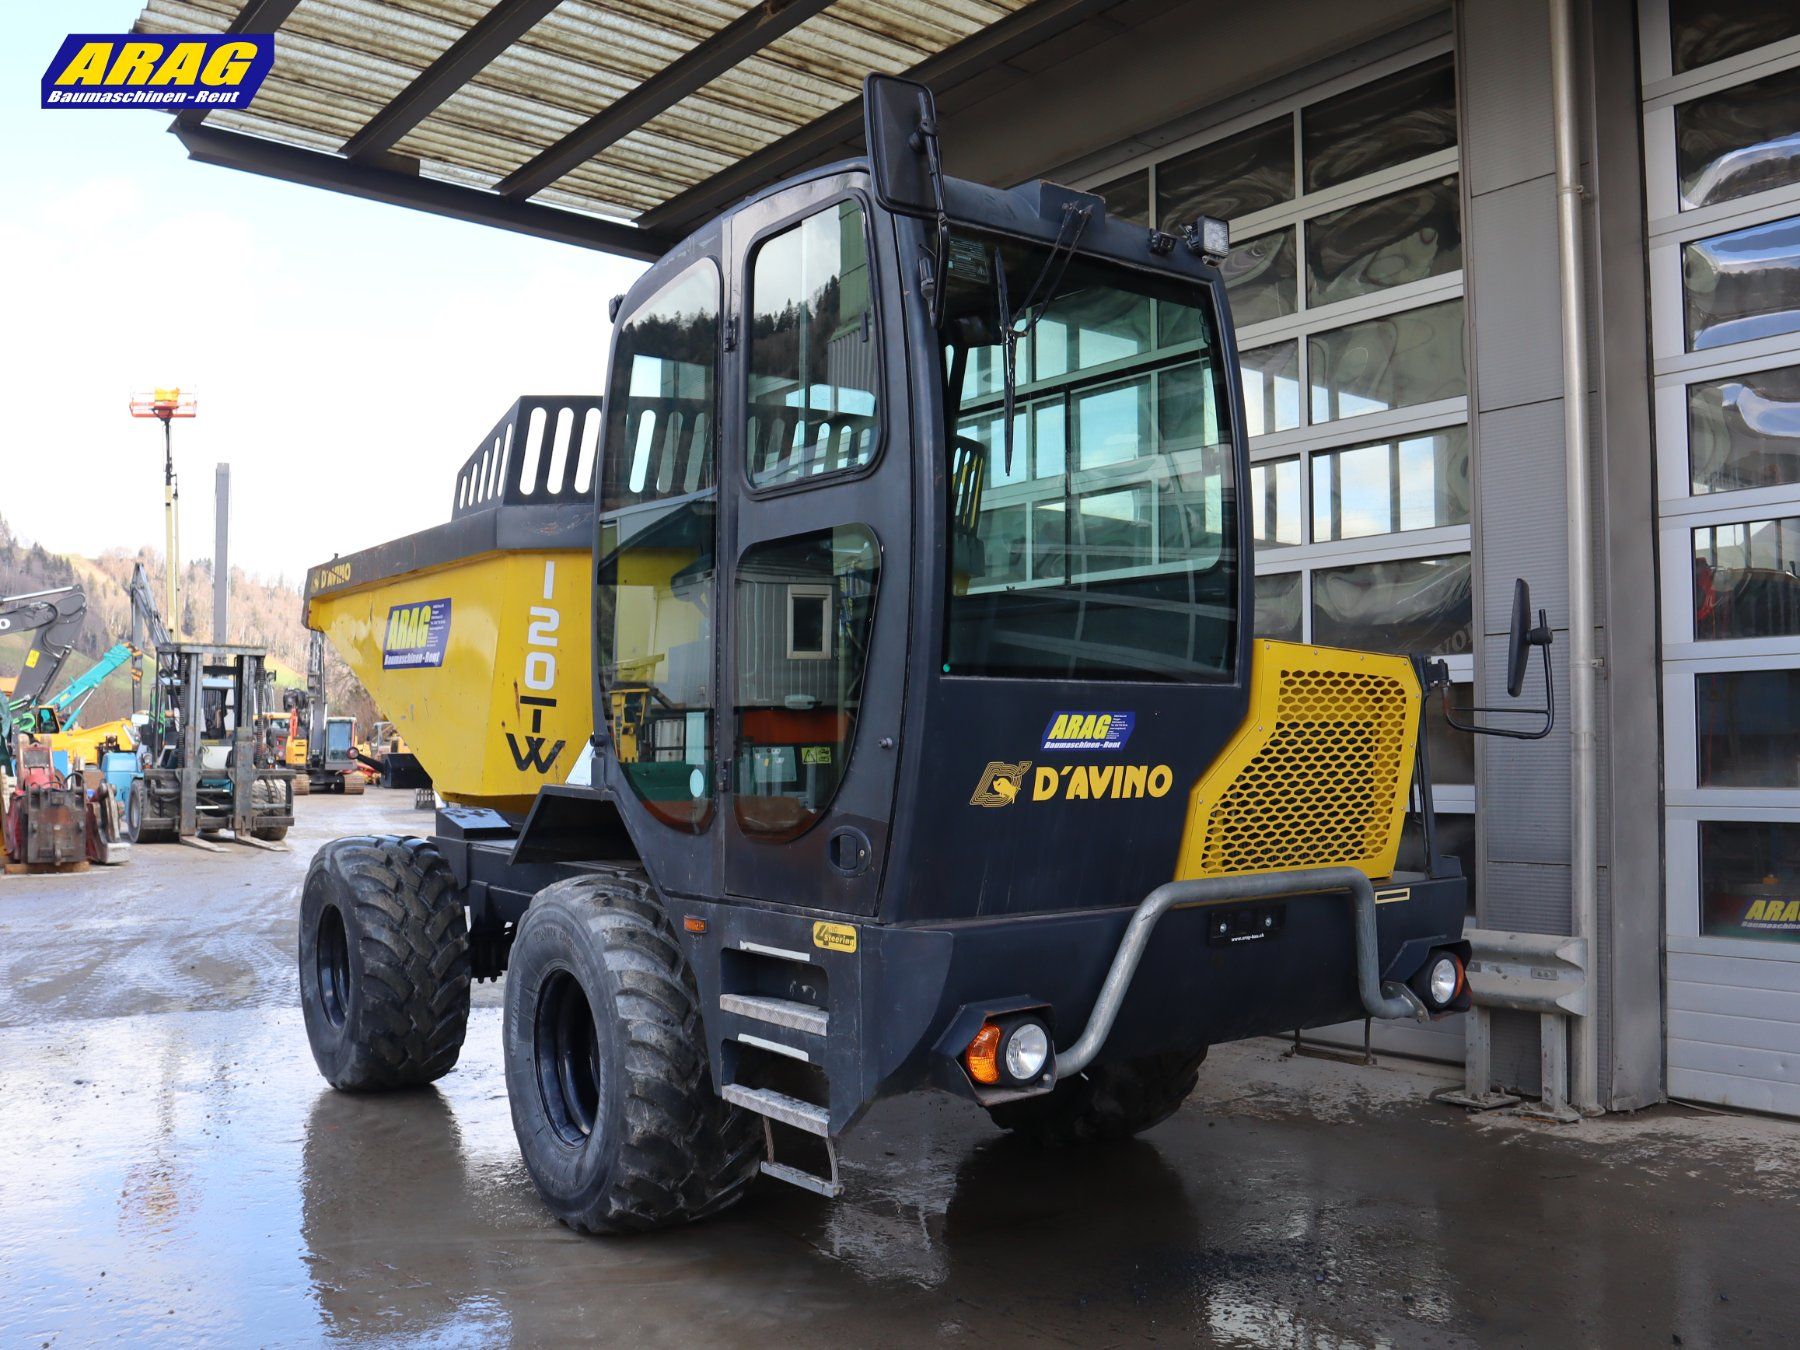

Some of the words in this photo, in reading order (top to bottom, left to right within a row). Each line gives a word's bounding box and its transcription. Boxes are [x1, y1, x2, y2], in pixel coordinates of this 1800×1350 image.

[386, 605, 431, 650] ARAG
[1047, 714, 1112, 740] ARAG
[1032, 764, 1174, 801] D'AVINO
[1745, 900, 1800, 921] ARA
